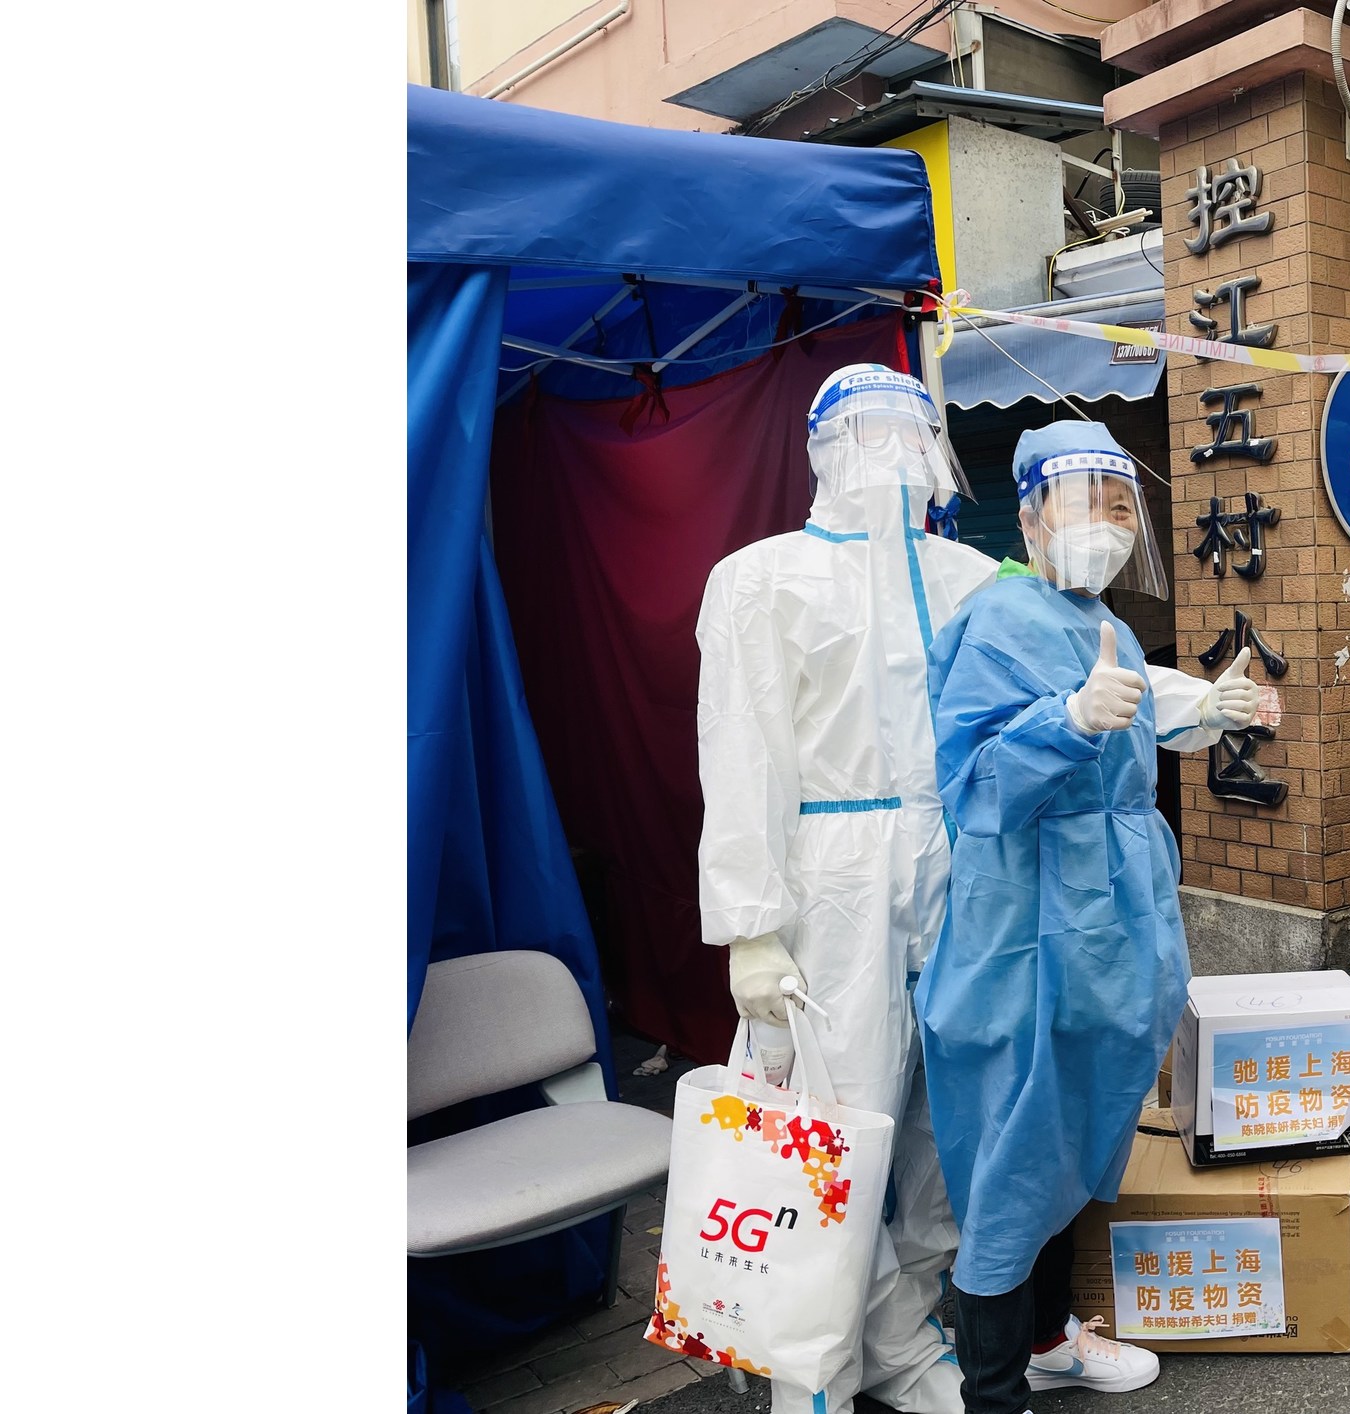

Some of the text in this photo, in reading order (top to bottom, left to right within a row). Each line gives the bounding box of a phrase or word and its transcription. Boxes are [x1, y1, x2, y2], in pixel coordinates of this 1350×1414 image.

[848, 375, 921, 389] Face shield
[1184, 157, 1289, 806] 控江五村小区
[1241, 1117, 1324, 1137] 陈晓陈妍希夫妇
[700, 1246, 770, 1275] 让未来生长
[1134, 1249, 1262, 1276] 驰援上海
[1136, 1282, 1263, 1312] 防疫物资
[1142, 1312, 1257, 1328] 陈晓陈妍希夫妇 捐赠
